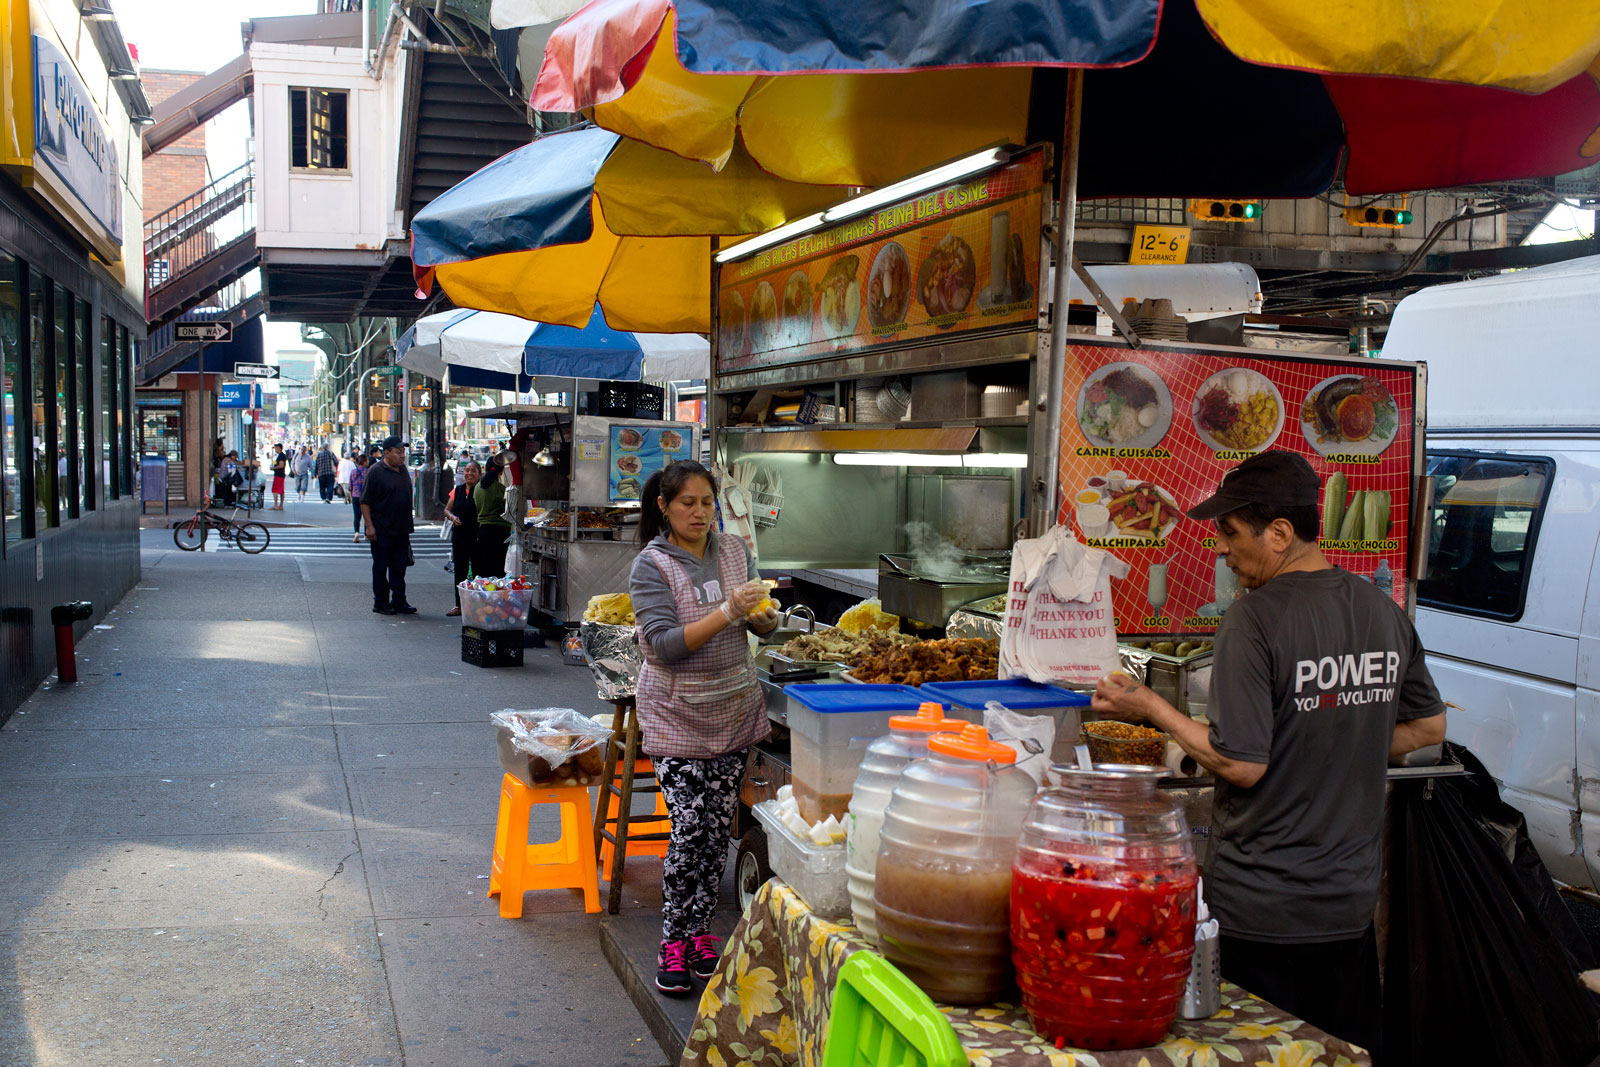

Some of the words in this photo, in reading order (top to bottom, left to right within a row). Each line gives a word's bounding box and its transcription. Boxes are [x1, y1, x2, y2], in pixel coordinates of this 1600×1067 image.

[772, 242, 797, 266] RICAS
[799, 215, 876, 258] ECUATORIANAS
[878, 204, 914, 232] REINA
[917, 194, 942, 220] DEL
[944, 177, 988, 211] CISNE
[1140, 253, 1177, 262] CLEARANCE
[182, 327, 198, 336] ONE
[206, 327, 223, 336] WAY
[241, 366, 255, 374] ONE
[1076, 447, 1115, 457] CARNE
[1118, 448, 1171, 458] GUISADA
[1215, 451, 1257, 460] GUATIT
[1326, 453, 1381, 464] MORCILLA
[1087, 538, 1166, 548] SALCHIPAPAS
[1319, 540, 1350, 549] HUMAS
[1352, 540, 1359, 549] Y
[1360, 540, 1398, 550] CHOCLOS
[1036, 610, 1077, 622] THANK
[1078, 608, 1105, 621] YOU
[1143, 617, 1170, 627] COCO
[1184, 616, 1222, 627] MOROCH
[1036, 627, 1079, 640] THANK
[1080, 626, 1106, 639] YOU
[1294, 651, 1400, 694] POWER
